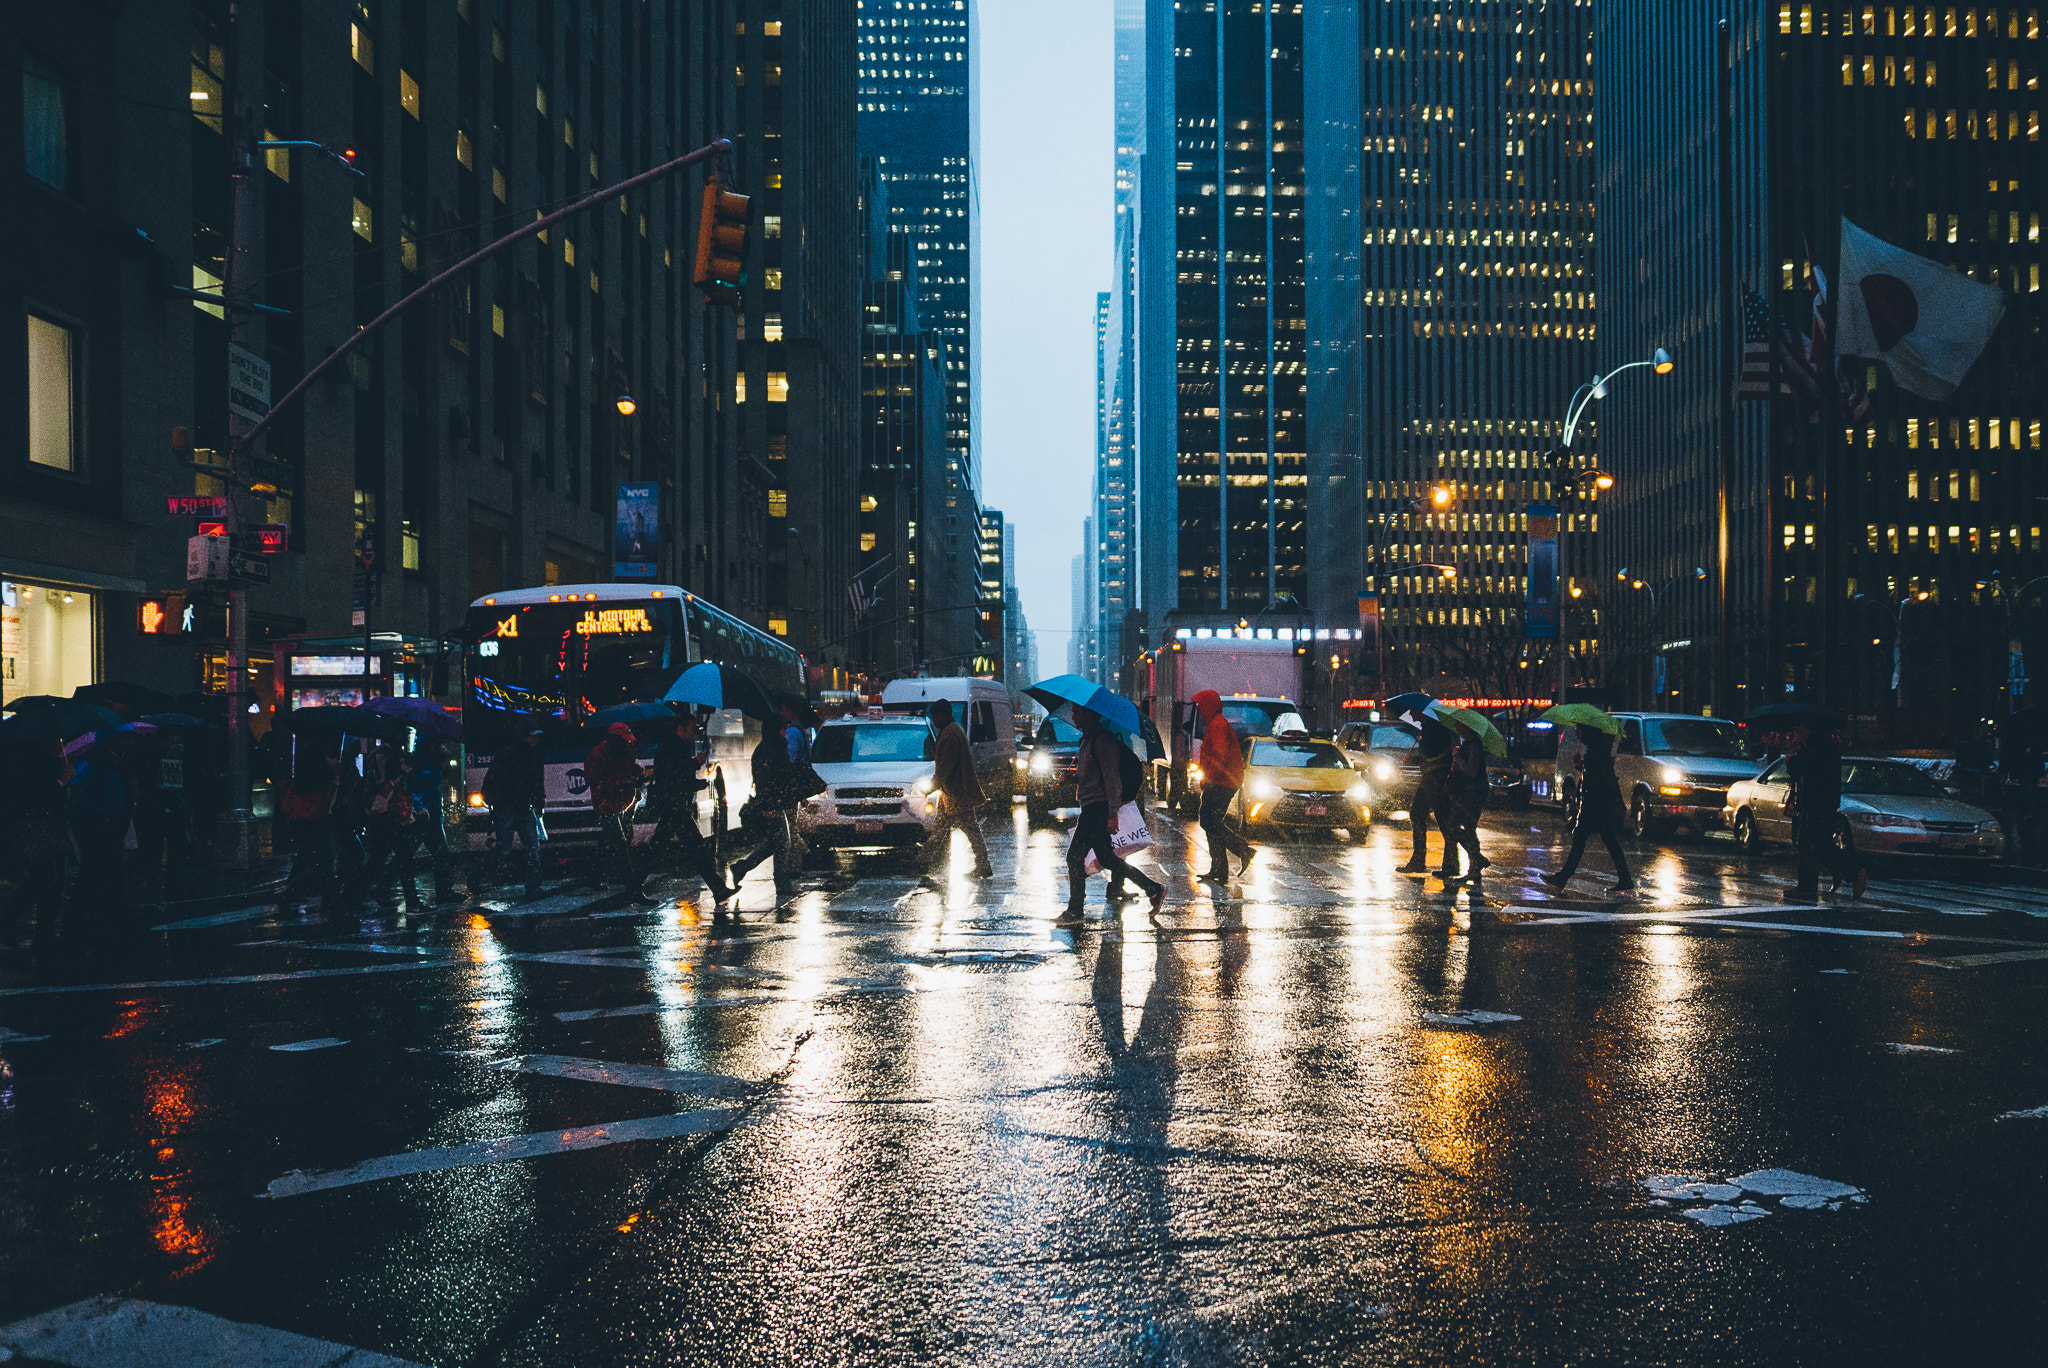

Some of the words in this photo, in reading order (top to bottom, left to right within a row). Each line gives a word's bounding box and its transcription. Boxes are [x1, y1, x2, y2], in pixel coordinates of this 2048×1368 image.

[627, 488, 650, 498] NYC
[167, 498, 179, 515] W
[180, 498, 198, 515] 50
[199, 498, 211, 508] ST
[584, 610, 597, 623] W.
[599, 609, 646, 621] MIDTOWN
[576, 621, 622, 634] CENTRAL
[624, 619, 639, 632] PK
[640, 619, 653, 631] S.
[566, 775, 587, 789] MTA
